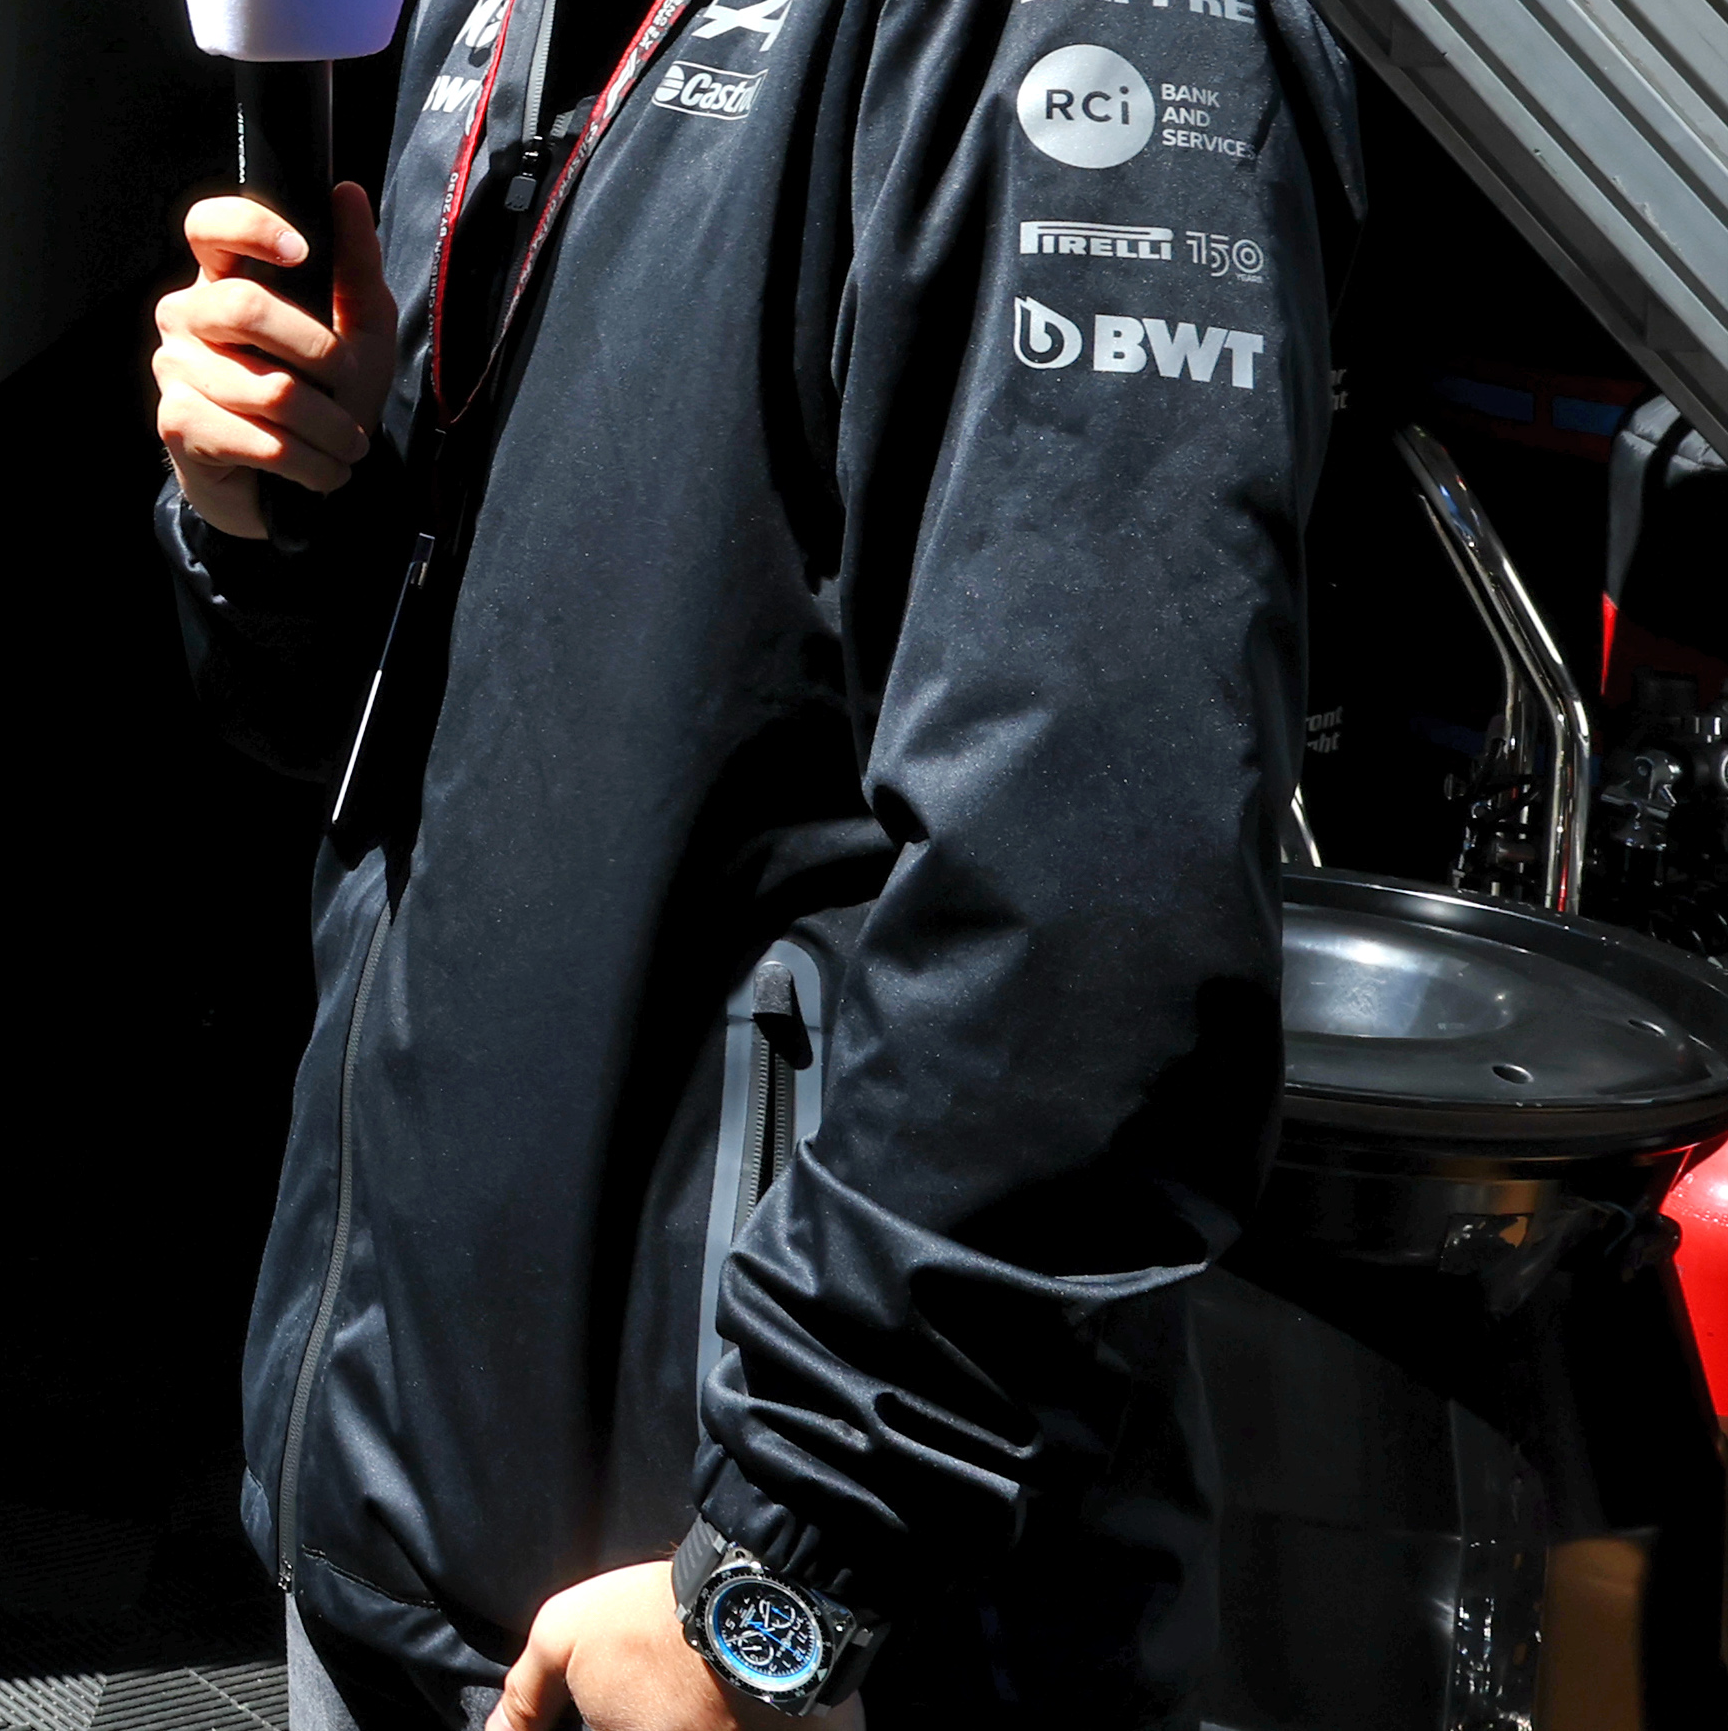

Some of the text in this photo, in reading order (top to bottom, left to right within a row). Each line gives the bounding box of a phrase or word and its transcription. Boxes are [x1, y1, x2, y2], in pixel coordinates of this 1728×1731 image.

[1160, 83, 1221, 108] BANK
[1161, 106, 1212, 128] AND
[1019, 220, 1175, 261] PIRELLI
[1092, 313, 1265, 390] BWT
